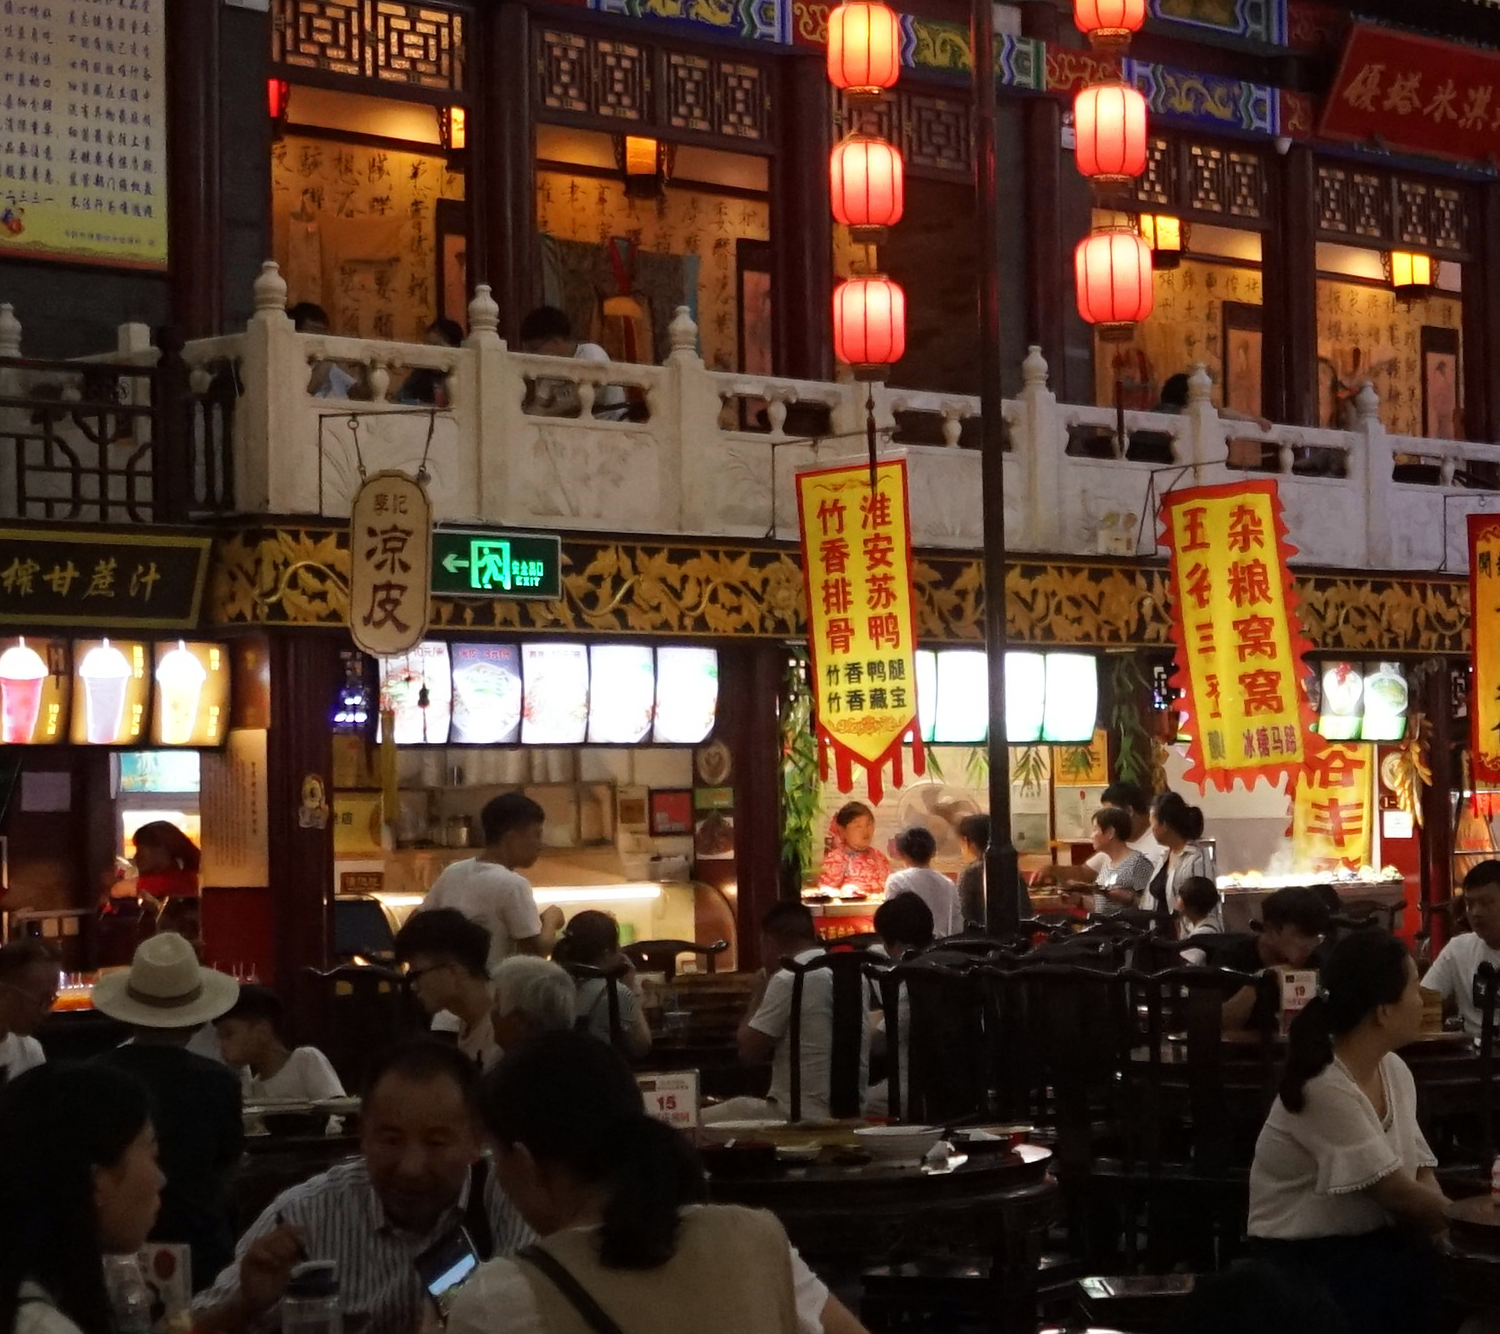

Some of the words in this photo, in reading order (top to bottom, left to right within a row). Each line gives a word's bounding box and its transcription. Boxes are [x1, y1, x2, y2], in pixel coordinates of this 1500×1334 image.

[362, 524, 413, 634] 凉皮
[515, 576, 541, 587] EXIT
[817, 498, 855, 655] 竹香排骨
[859, 492, 900, 650] 淮安苏鸭
[1228, 505, 1284, 718] 杂粮窝窝
[826, 659, 906, 687] 竹香鸭腿
[827, 686, 908, 714] 竹香藏宝
